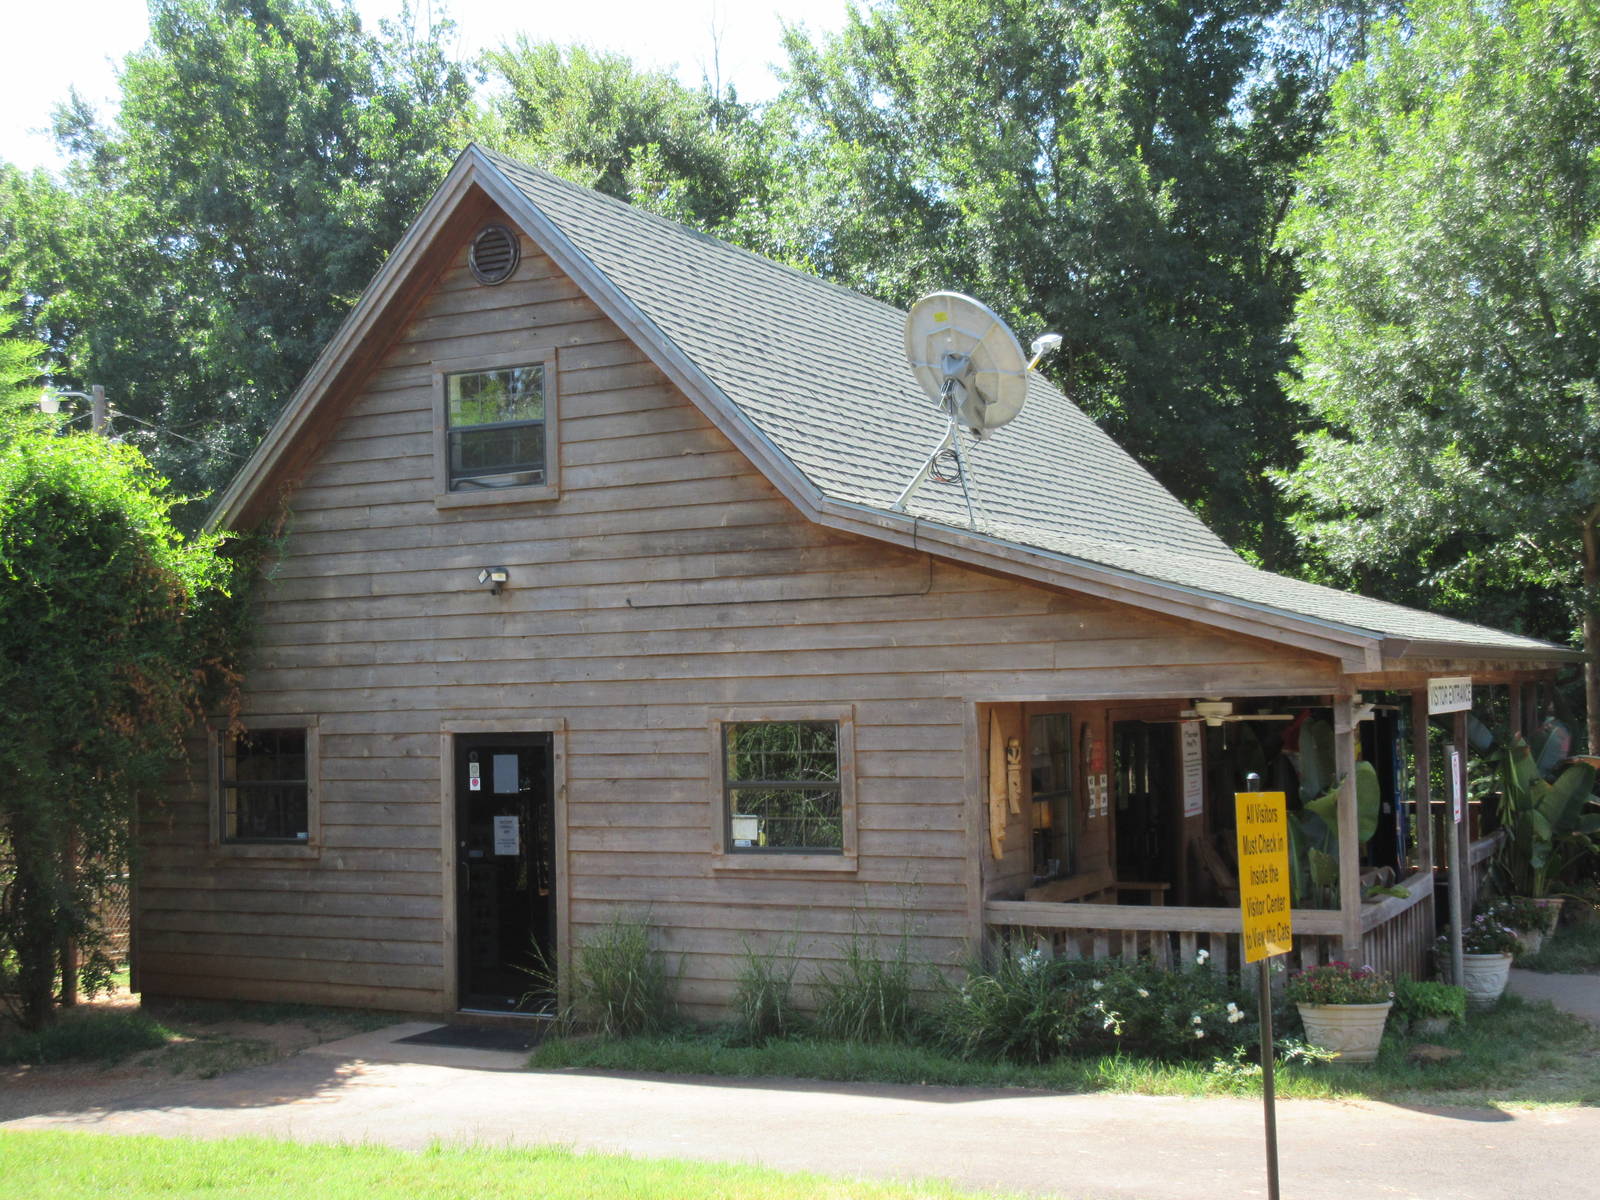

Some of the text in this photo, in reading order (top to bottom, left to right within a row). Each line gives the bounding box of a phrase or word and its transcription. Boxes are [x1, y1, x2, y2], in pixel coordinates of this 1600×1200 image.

[1246, 803, 1278, 824] All Visitors
[1243, 834, 1257, 855] Must
[1258, 833, 1277, 853] Check
[1269, 863, 1279, 883] the
[1246, 894, 1286, 918] Visitor Center
[1246, 922, 1290, 950] to View the Cats
